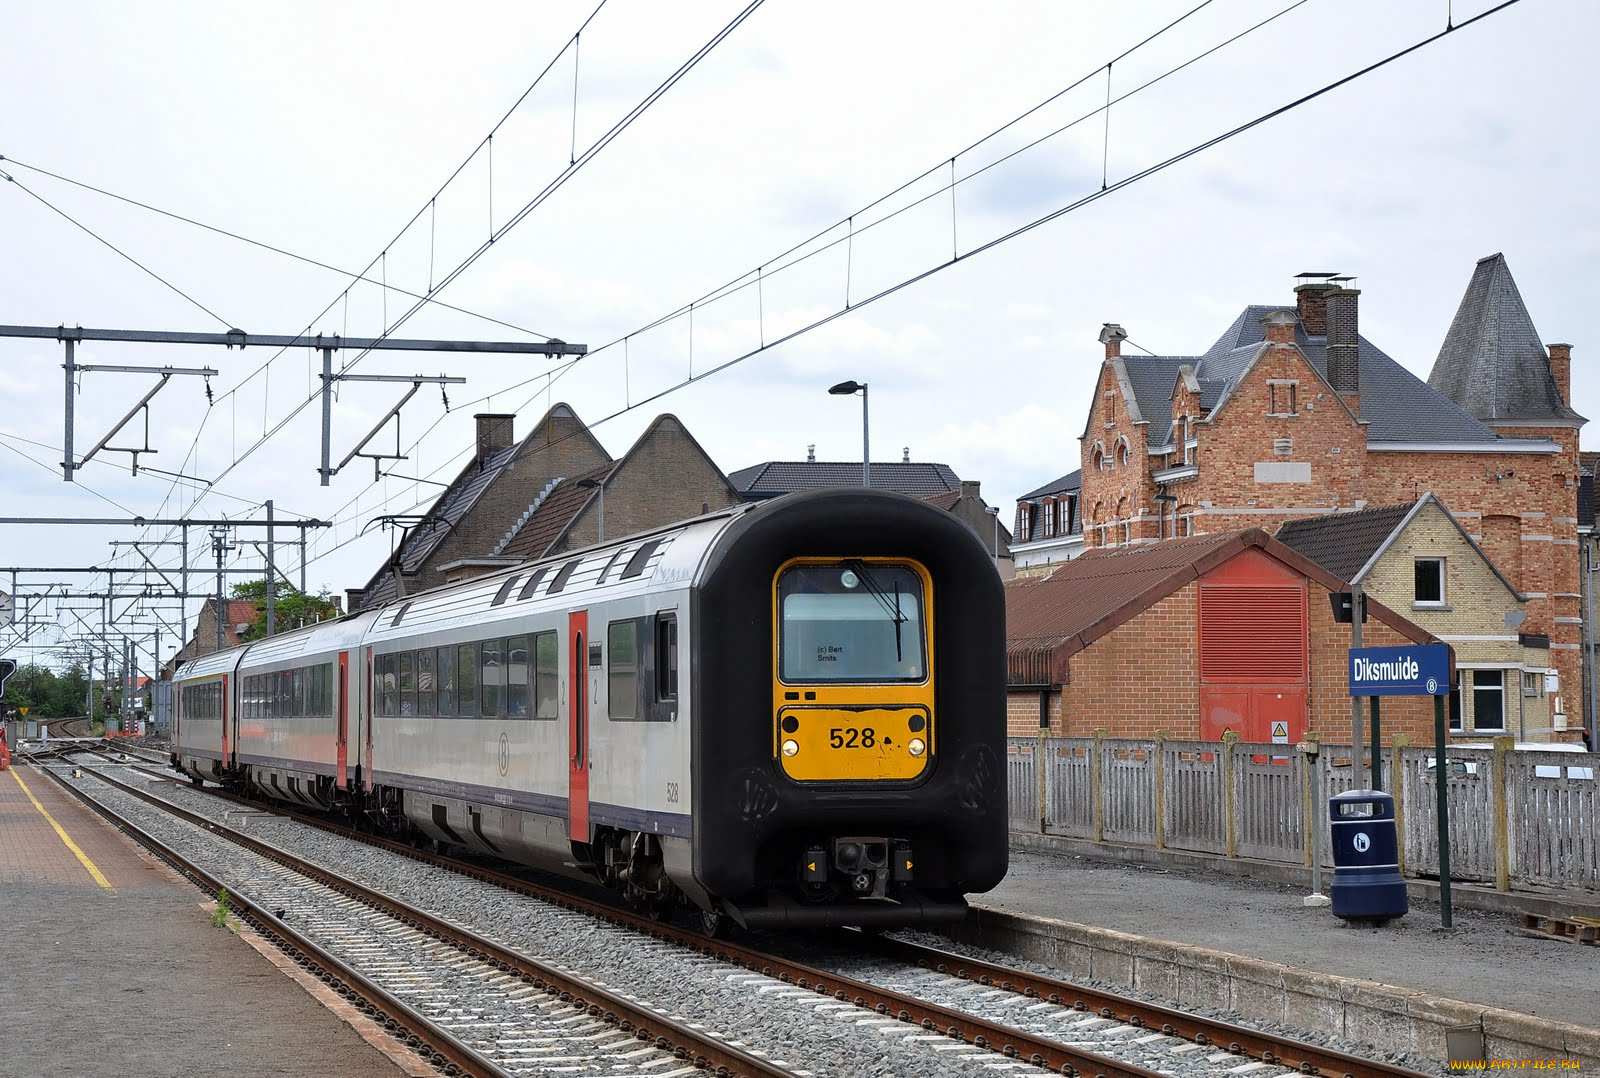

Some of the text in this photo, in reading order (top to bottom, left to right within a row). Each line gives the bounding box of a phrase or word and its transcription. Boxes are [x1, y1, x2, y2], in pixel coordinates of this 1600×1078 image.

[1354, 656, 1419, 681] Diksmuide
[561, 680, 566, 706] 2
[593, 679, 598, 704] 2
[829, 727, 876, 749] 528
[666, 782, 679, 803] 528
